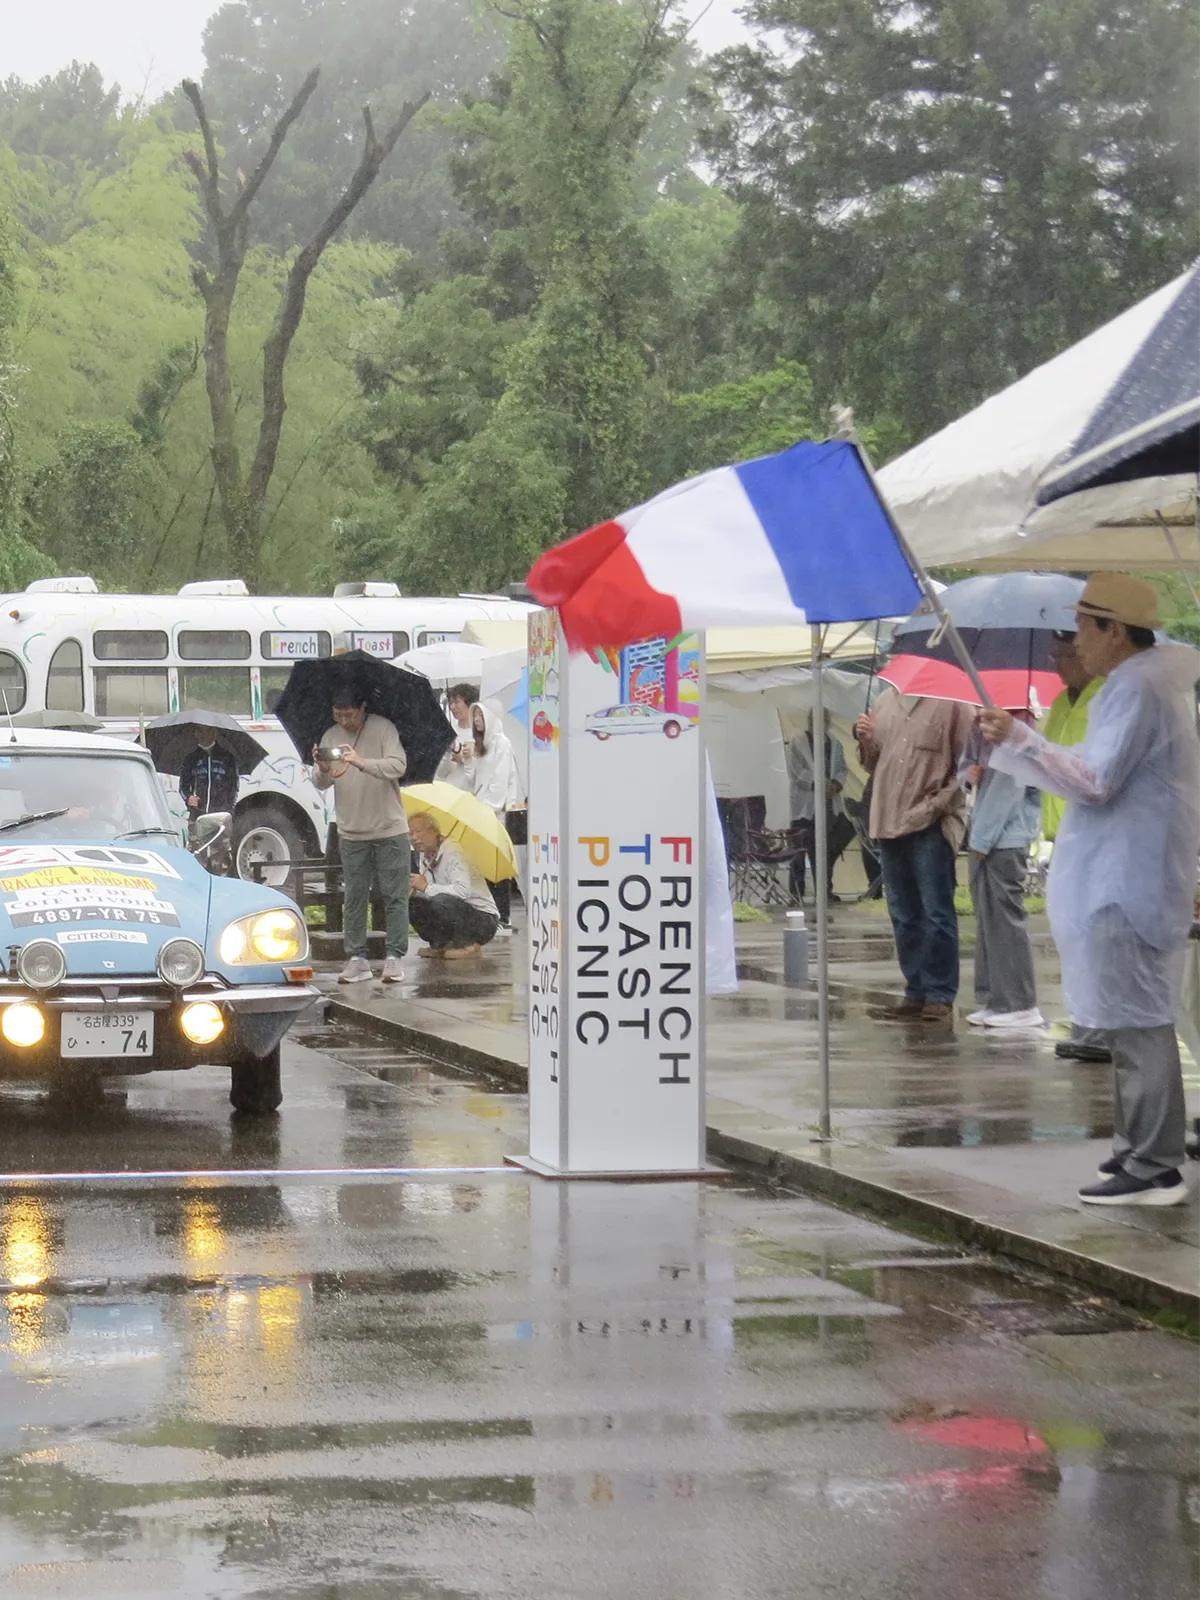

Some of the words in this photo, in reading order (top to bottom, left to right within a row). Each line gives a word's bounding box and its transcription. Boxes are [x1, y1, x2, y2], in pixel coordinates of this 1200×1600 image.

[273, 633, 317, 655] French
[357, 637, 392, 651] Toast
[1, 876, 65, 893] RALLYE
[82, 875, 156, 892] BANDAMA
[107, 888, 132, 897] DE
[32, 908, 128, 924] 4897-YR
[135, 910, 161, 924] 75
[66, 931, 128, 941] CITROËN
[531, 834, 541, 1038] PICNIC
[540, 833, 550, 1038] TOAST
[575, 836, 611, 1046] PICNIC
[617, 833, 652, 1040] TOAST
[549, 836, 559, 1084] FRENCH
[658, 836, 693, 1085] FRENCH
[67, 1037, 78, 1049] ひ
